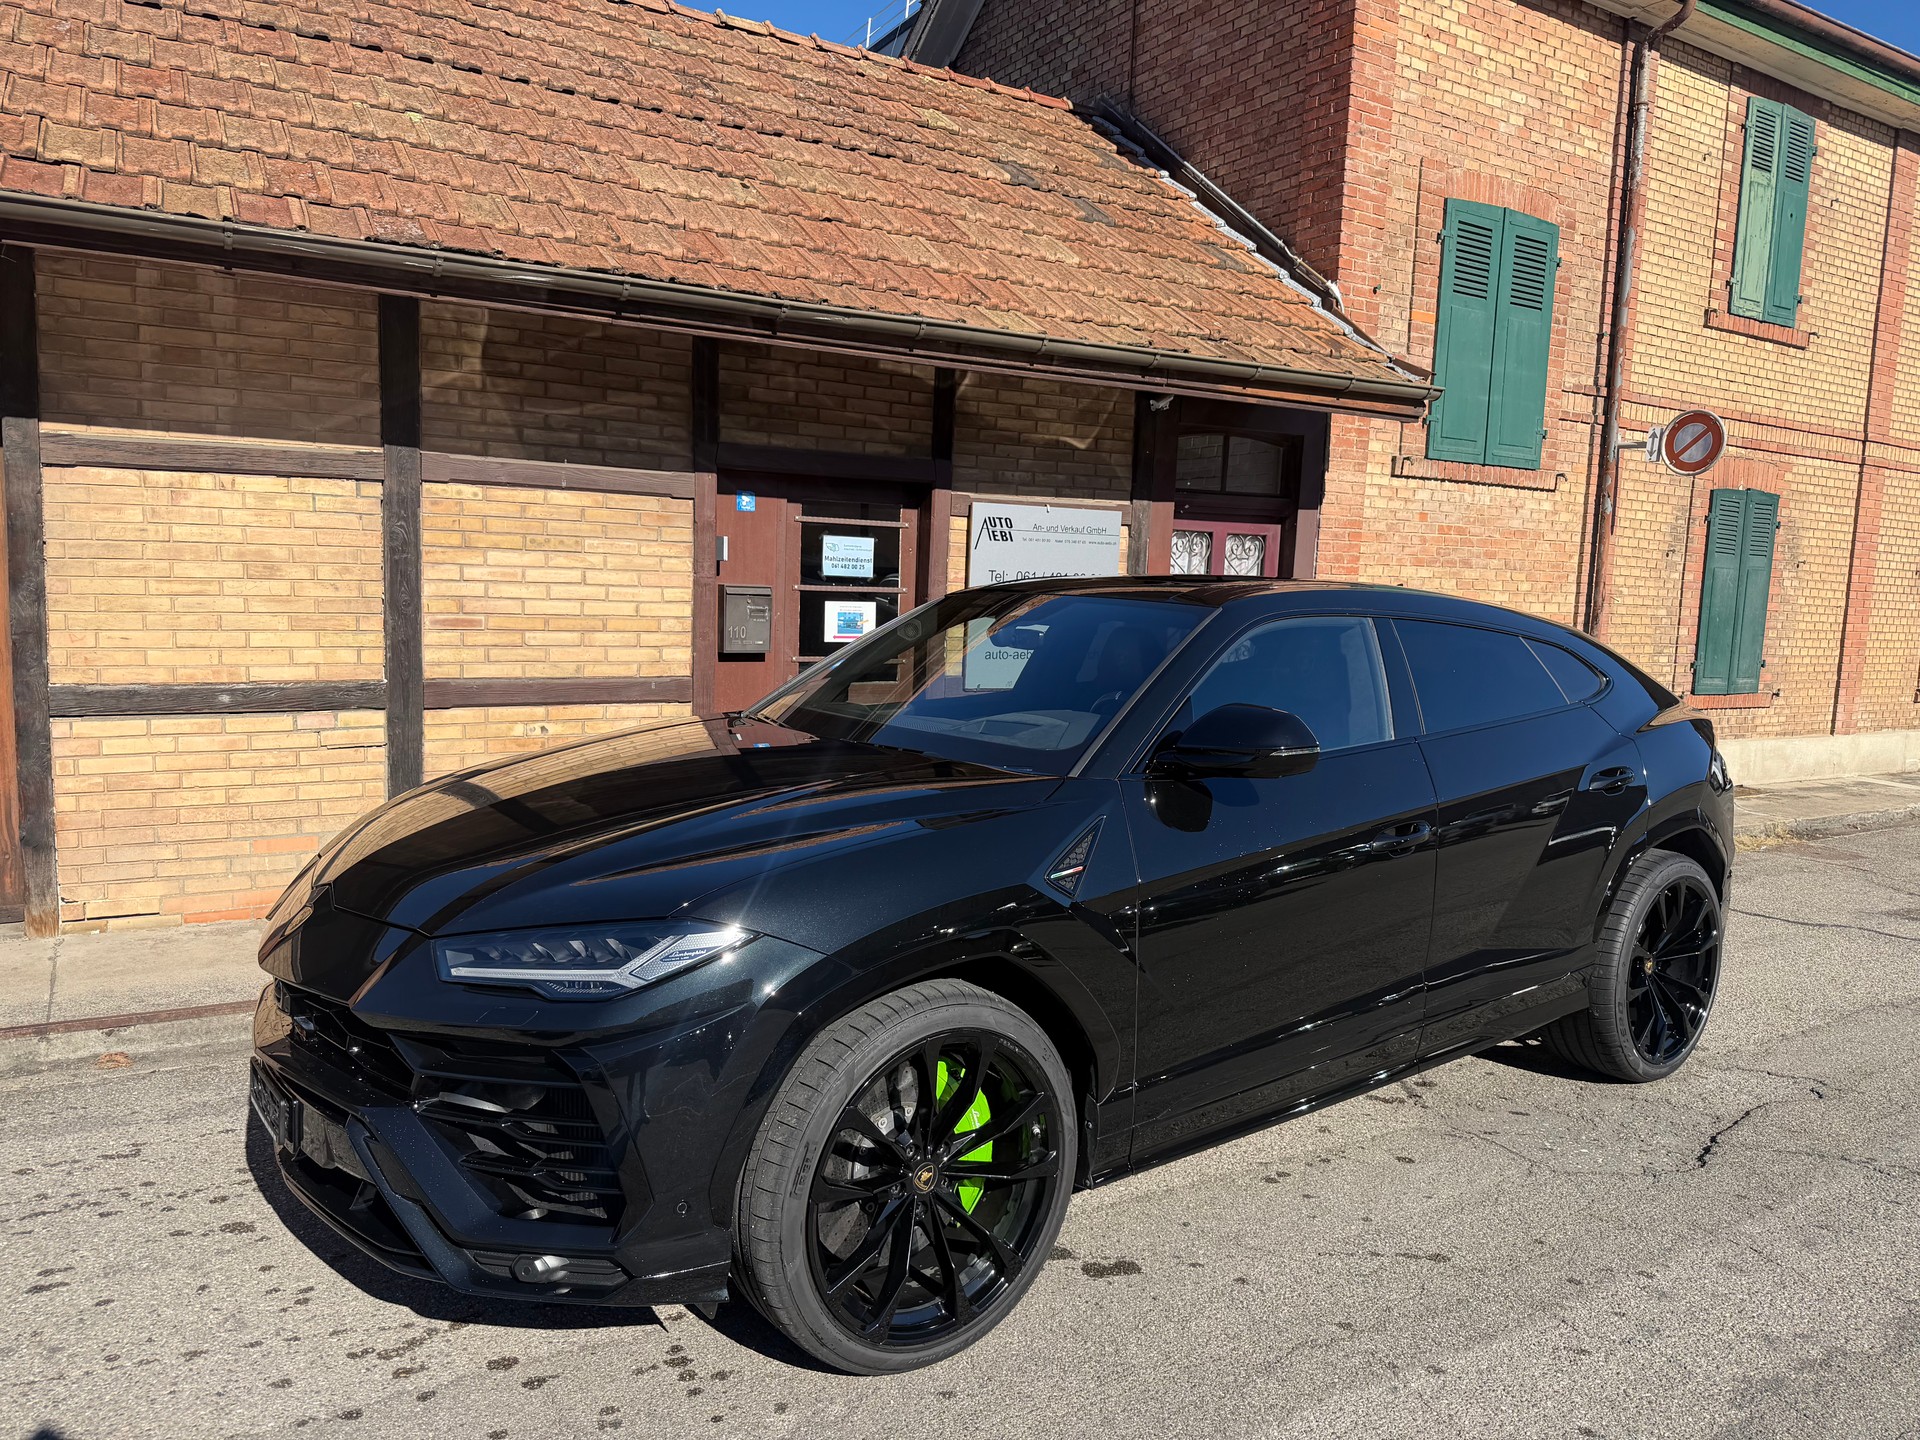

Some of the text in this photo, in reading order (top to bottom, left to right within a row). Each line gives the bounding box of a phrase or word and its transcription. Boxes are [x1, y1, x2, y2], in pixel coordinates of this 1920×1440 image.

[1032, 523, 1044, 531] An-
[1060, 524, 1085, 533] Verkauf
[1086, 526, 1107, 534] GmbH
[824, 555, 873, 564] Mahlzeitendienst
[728, 625, 746, 638] 110
